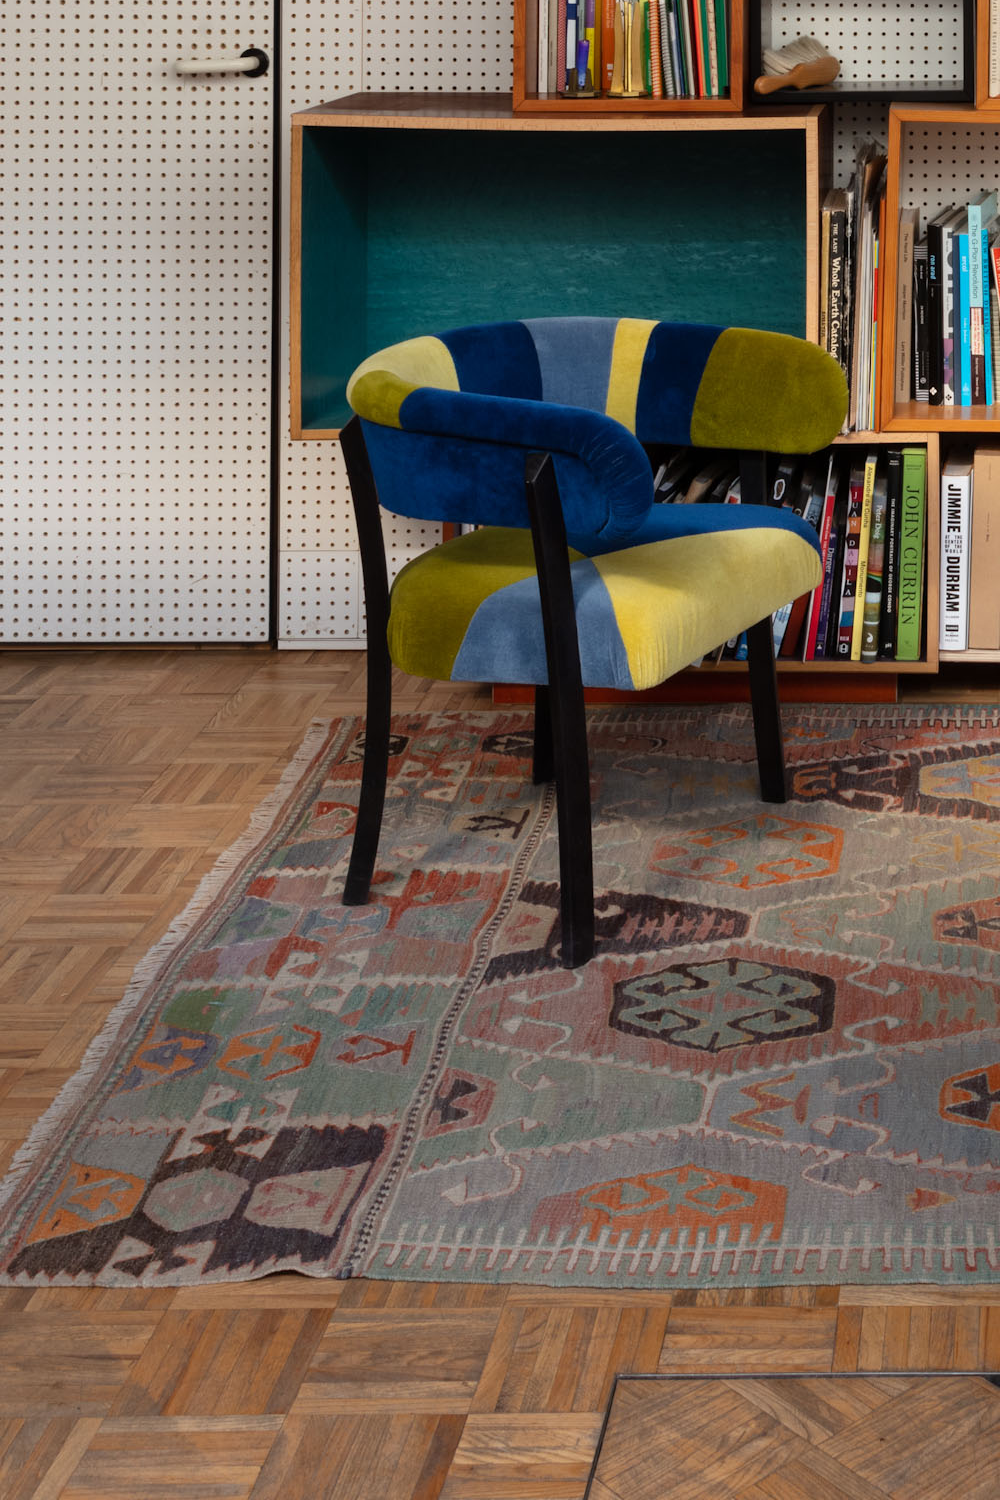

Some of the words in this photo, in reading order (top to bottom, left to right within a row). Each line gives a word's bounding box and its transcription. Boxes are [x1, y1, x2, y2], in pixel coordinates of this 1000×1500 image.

[832, 223, 840, 236] THE
[971, 223, 980, 236] The
[832, 238, 840, 254] LAST
[971, 237, 980, 264] G-Plan
[831, 257, 842, 288] Whole
[930, 266, 938, 280] arad
[972, 265, 980, 300] Revolution
[831, 289, 842, 318] Earth
[829, 320, 840, 358] Catalog
[865, 466, 874, 498] Alexandre
[864, 498, 870, 508] da
[875, 504, 884, 522] Peter
[904, 485, 920, 538] JOHN
[947, 484, 962, 534] JIMMIE
[873, 523, 882, 540] Doig
[825, 547, 834, 574] Darger
[857, 560, 866, 598] Monumento
[901, 547, 918, 626] CURRIN
[946, 556, 960, 612] DURHAM
